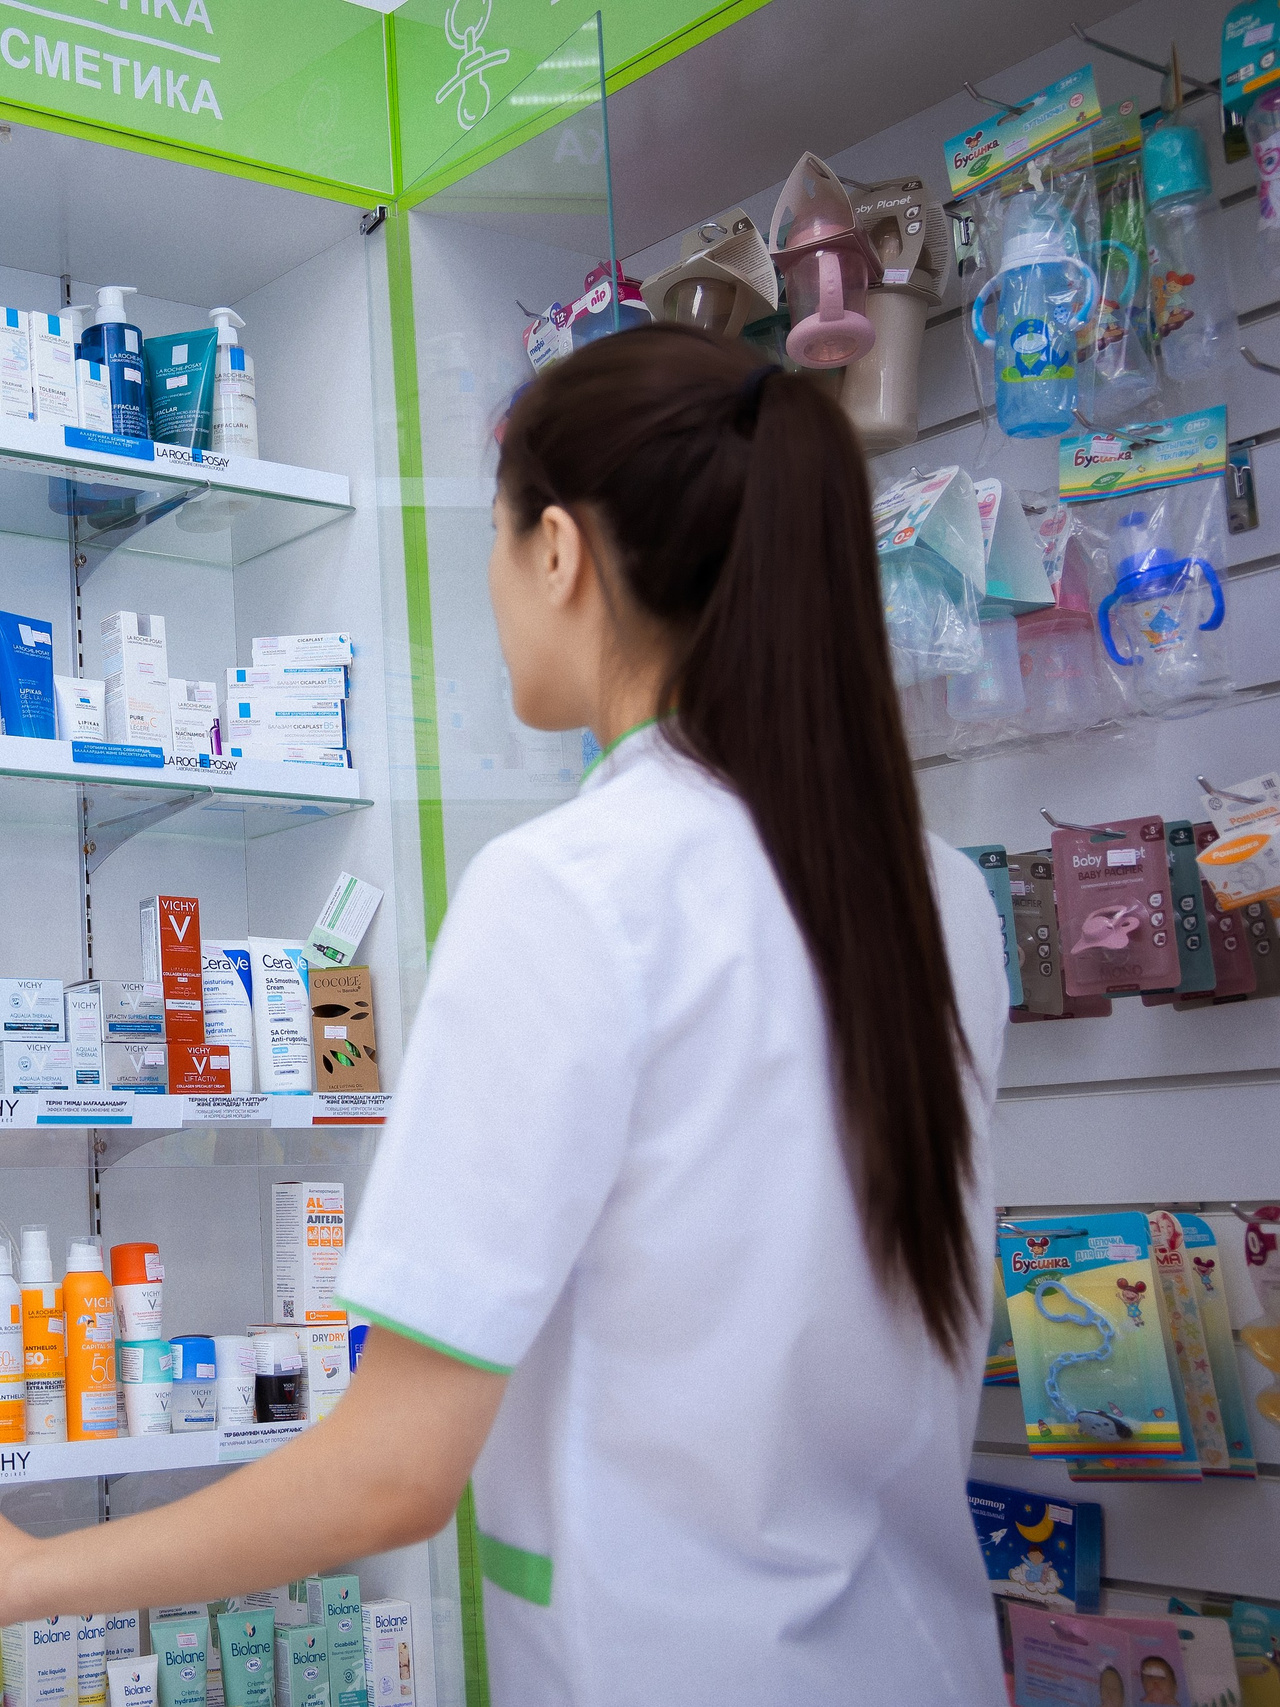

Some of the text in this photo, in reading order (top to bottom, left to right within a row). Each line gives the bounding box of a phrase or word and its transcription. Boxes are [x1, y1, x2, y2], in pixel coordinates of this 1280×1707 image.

[954, 139, 1000, 169] Бусинка
[591, 289, 606, 306] nip
[39, 386, 66, 396] TOLERIANE
[157, 448, 229, 468] LA ROCHE POSAY
[164, 755, 237, 770] LA ROCHE POSAY
[1073, 853, 1101, 868] Baby
[1078, 865, 1143, 881] BABY PACIFIER
[162, 900, 196, 912] VICHY
[263, 954, 307, 970] CeraVe
[307, 1215, 343, 1224] АЛГЕЛЬ
[1089, 1237, 1123, 1247] ЦЕПОЧКА
[1012, 1253, 1071, 1272] Бусинка
[26, 1353, 51, 1365] 50+
[328, 1604, 359, 1615] Biolane
[376, 1615, 407, 1627] Biolane
[34, 1629, 70, 1644] Biolane
[231, 1642, 270, 1656] Biolane
[166, 1651, 204, 1666] Biolane
[293, 1652, 326, 1664] Biolane
[125, 1684, 151, 1696] Biolane
